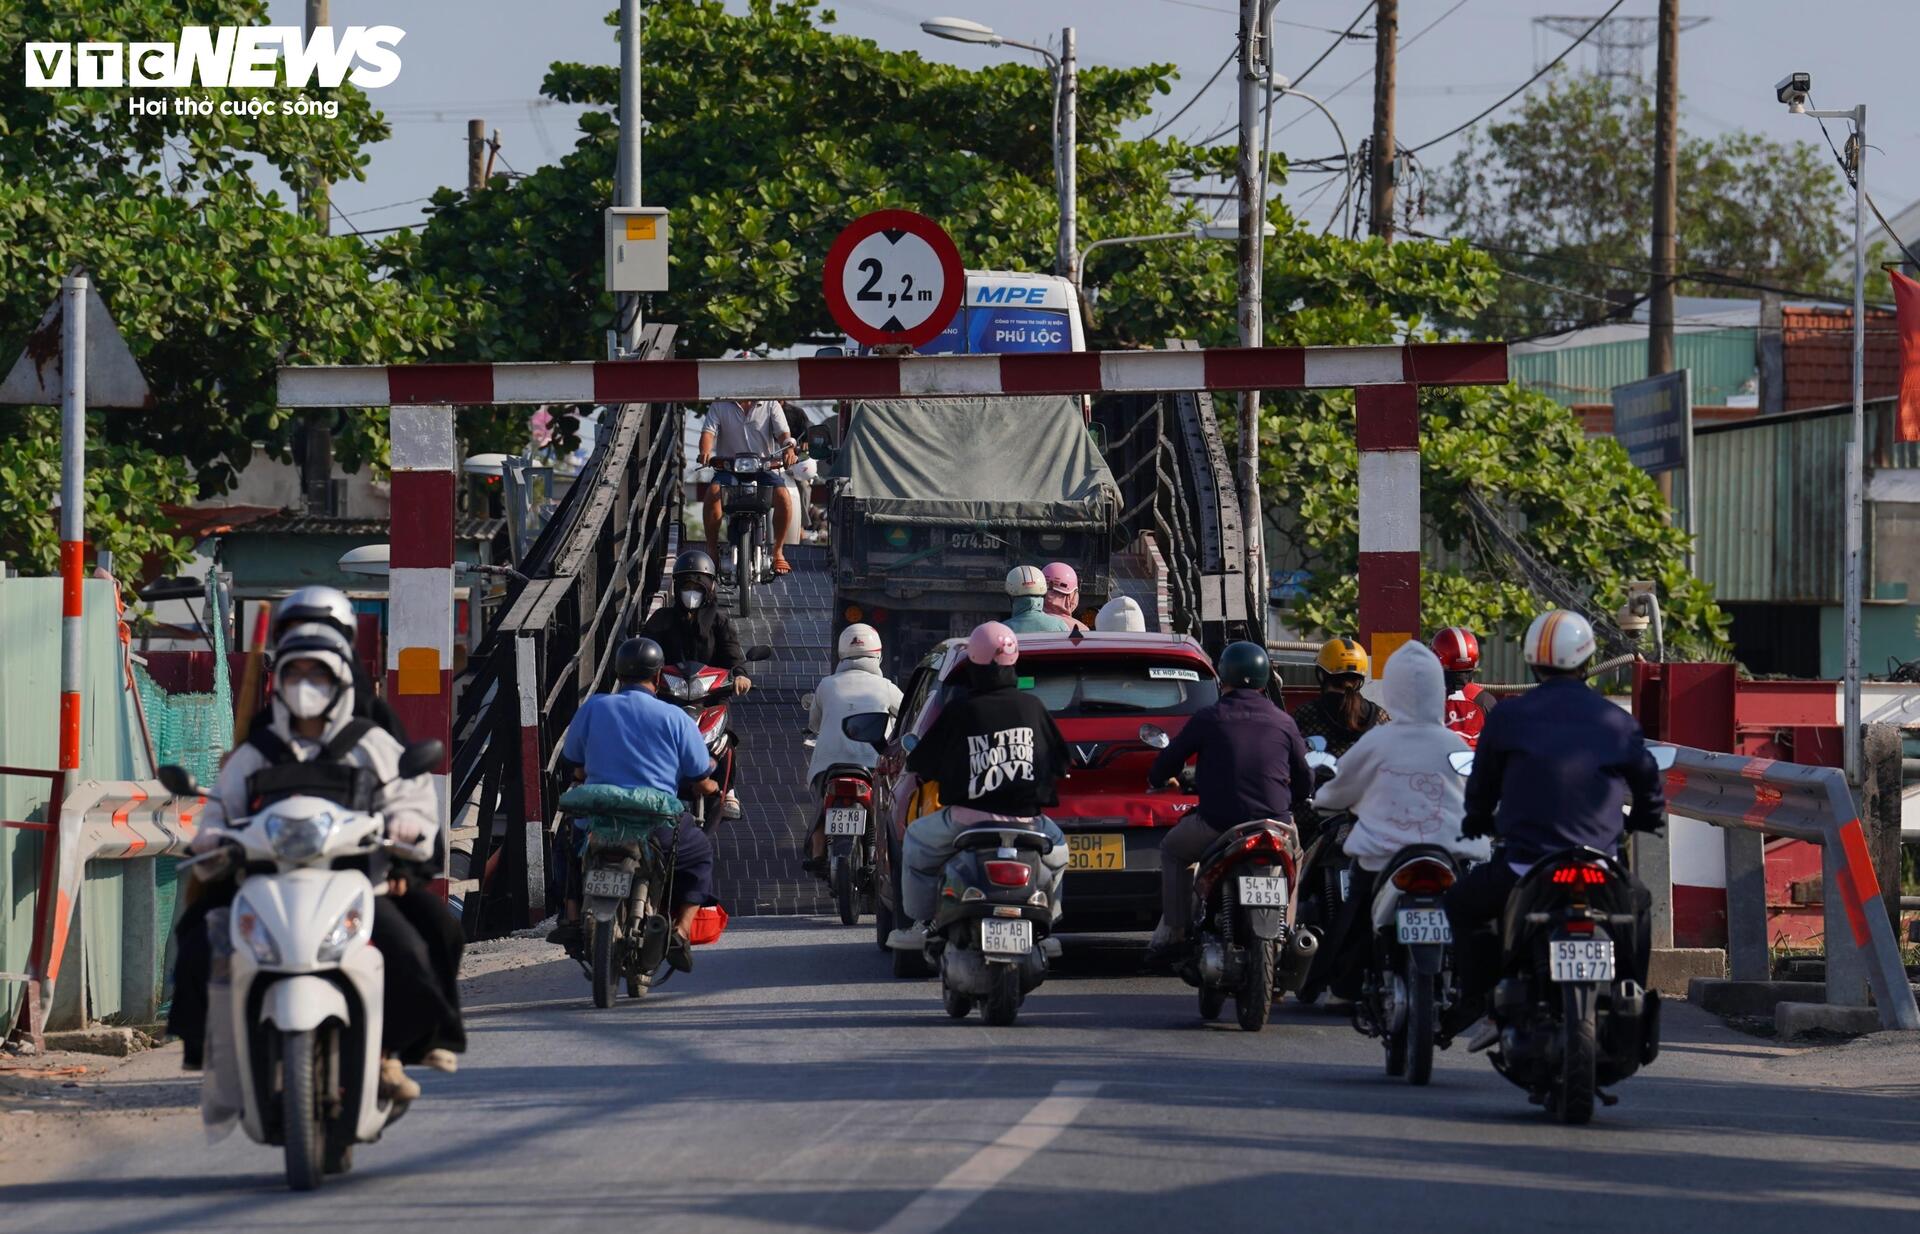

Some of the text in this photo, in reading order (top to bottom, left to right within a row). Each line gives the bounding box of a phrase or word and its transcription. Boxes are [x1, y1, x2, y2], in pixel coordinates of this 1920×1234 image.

[976, 286, 1048, 304] MPE
[996, 327, 1062, 346] PHÚ LỘC
[967, 727, 1034, 756] IN THE
[969, 745, 1033, 778] MOOD FOR
[968, 760, 1035, 800] LOVE
[832, 810, 859, 822] 73-K8
[830, 823, 857, 833] 8911
[1069, 836, 1102, 851] 50H
[1068, 853, 1116, 868] 30.17
[1245, 878, 1278, 891] 54-N7
[1246, 892, 1280, 904] 2859
[1406, 911, 1444, 926] 85-E1
[989, 921, 1022, 936] 50-AB
[1401, 926, 1451, 941] 097.00
